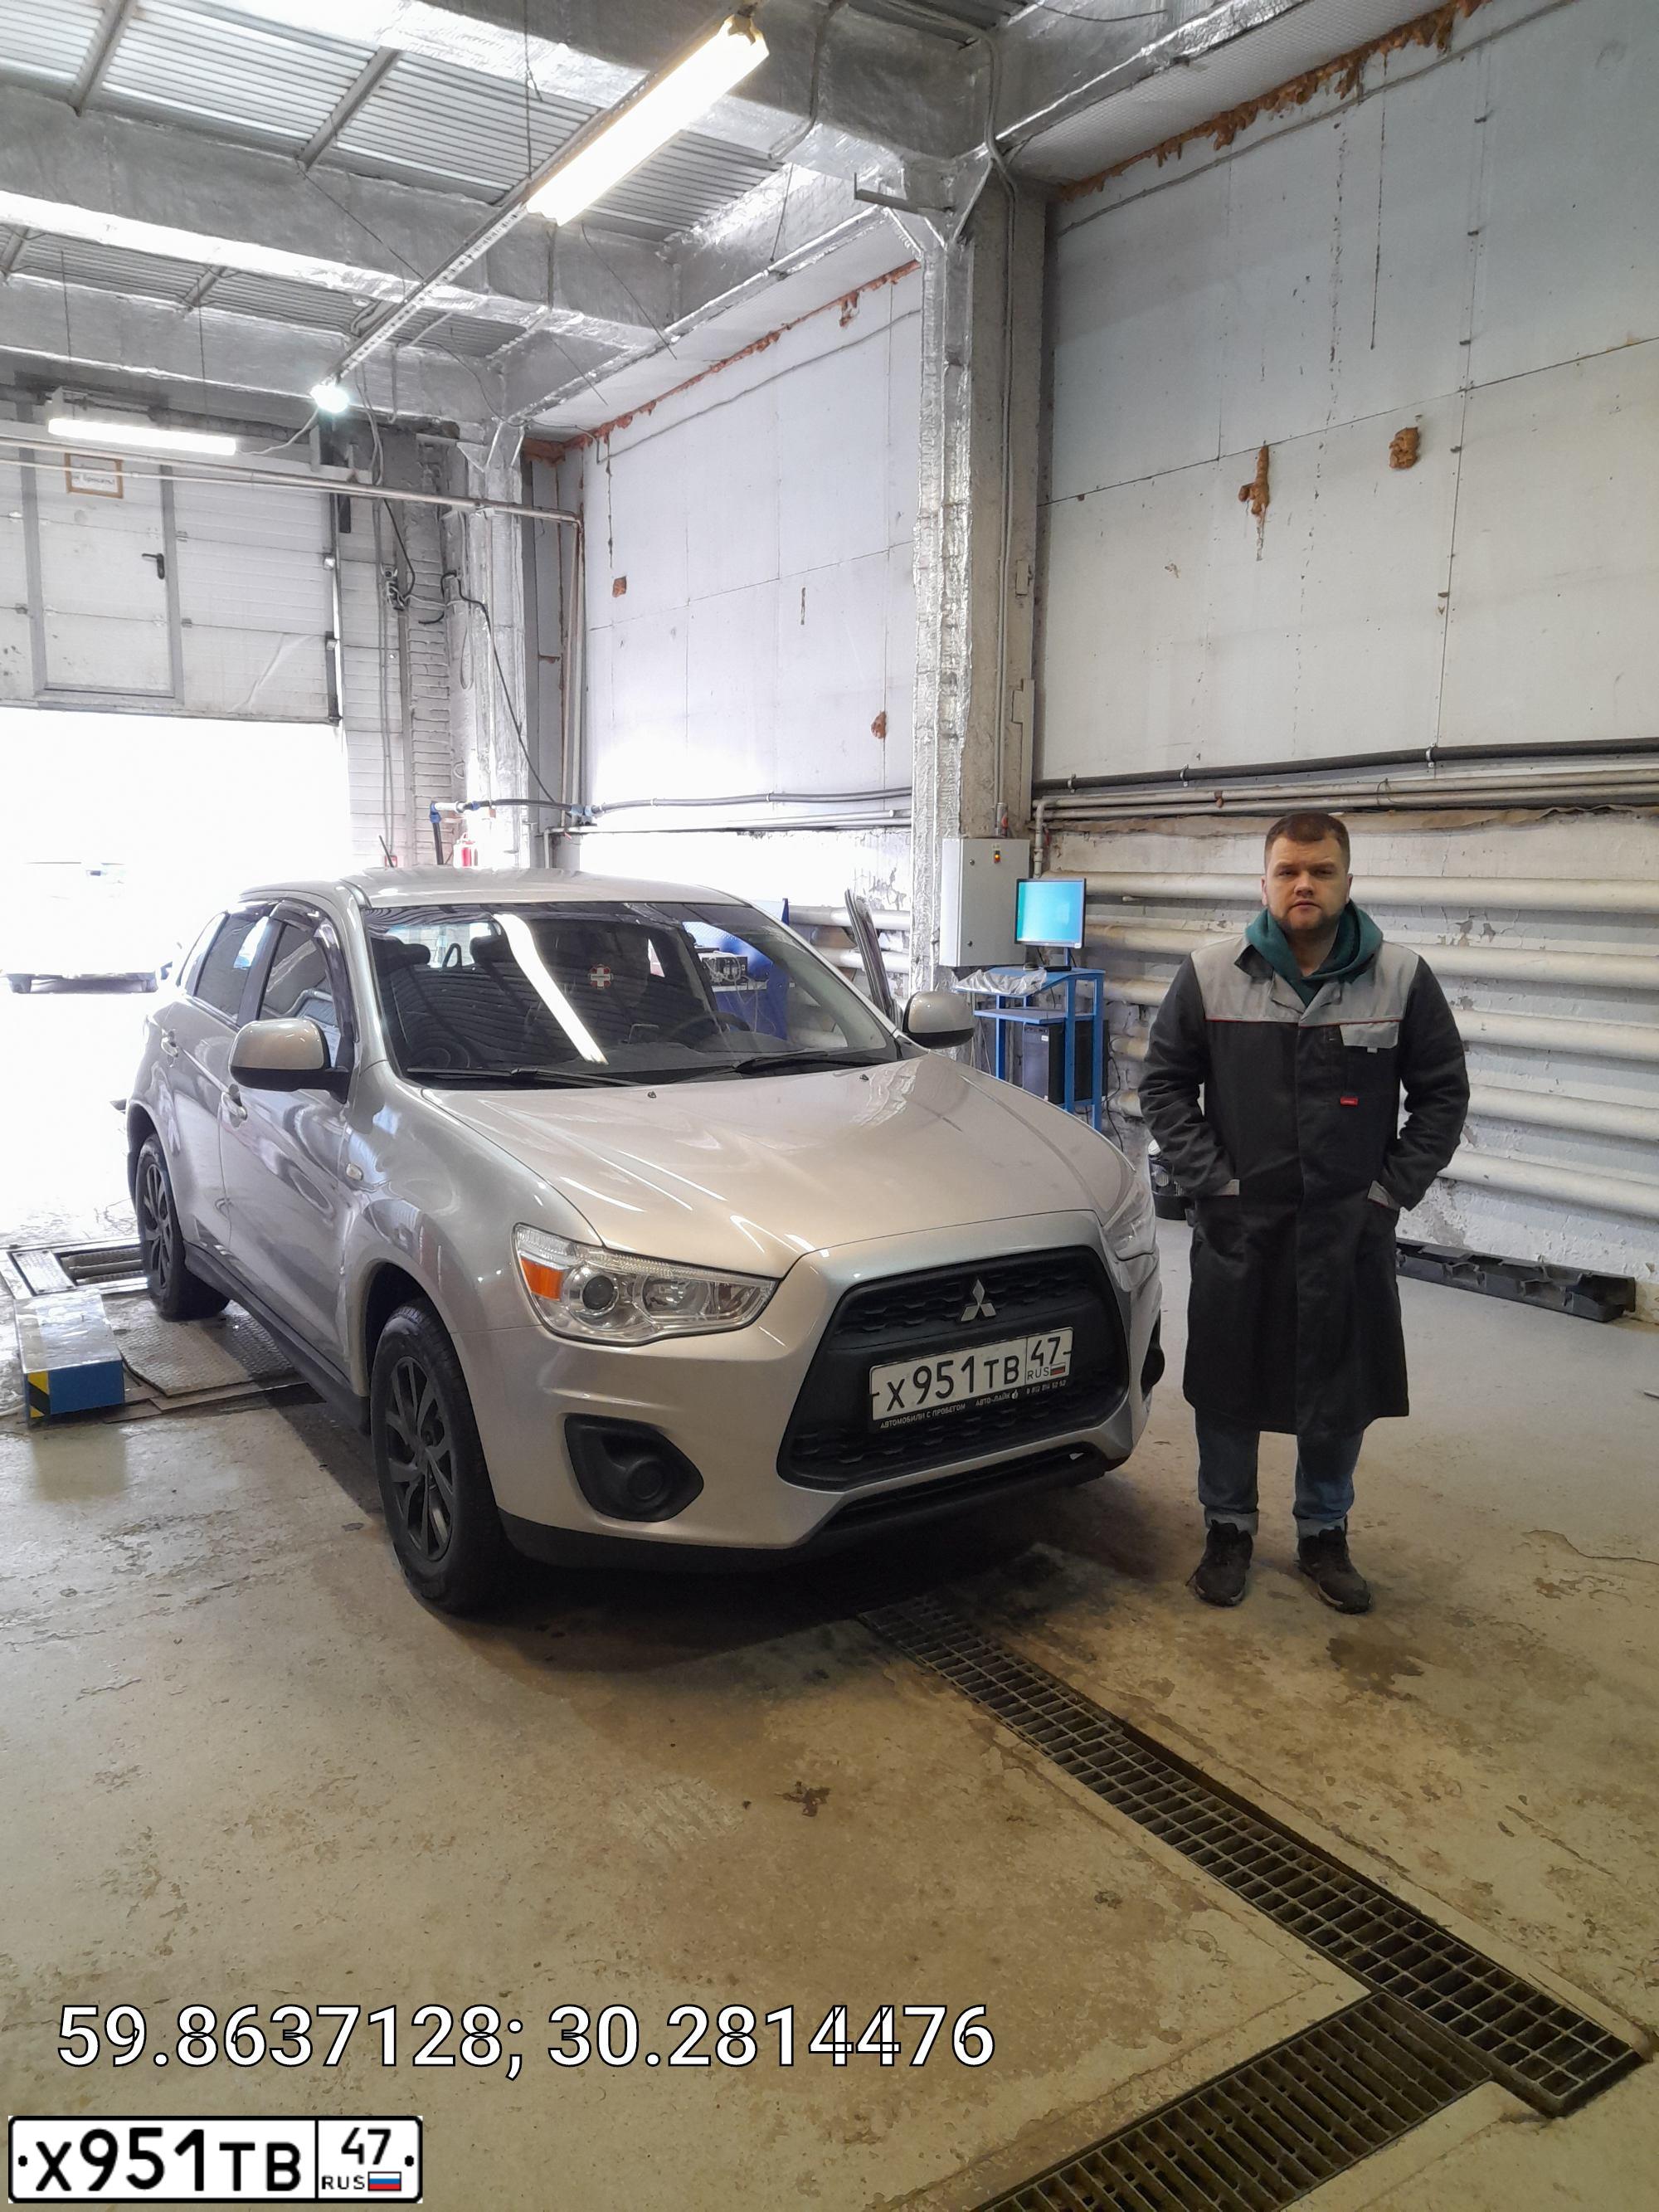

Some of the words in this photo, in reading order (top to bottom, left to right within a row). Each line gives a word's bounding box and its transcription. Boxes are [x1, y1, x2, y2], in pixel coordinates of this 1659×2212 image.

[1030, 1336, 1062, 1367] 47
[887, 1356, 1019, 1411] Х951ТВ
[1026, 1369, 1050, 1381] RUS
[880, 1414, 925, 1428] АВТОМОБИЛИ
[932, 1403, 966, 1416] ПРОБЕГОМ
